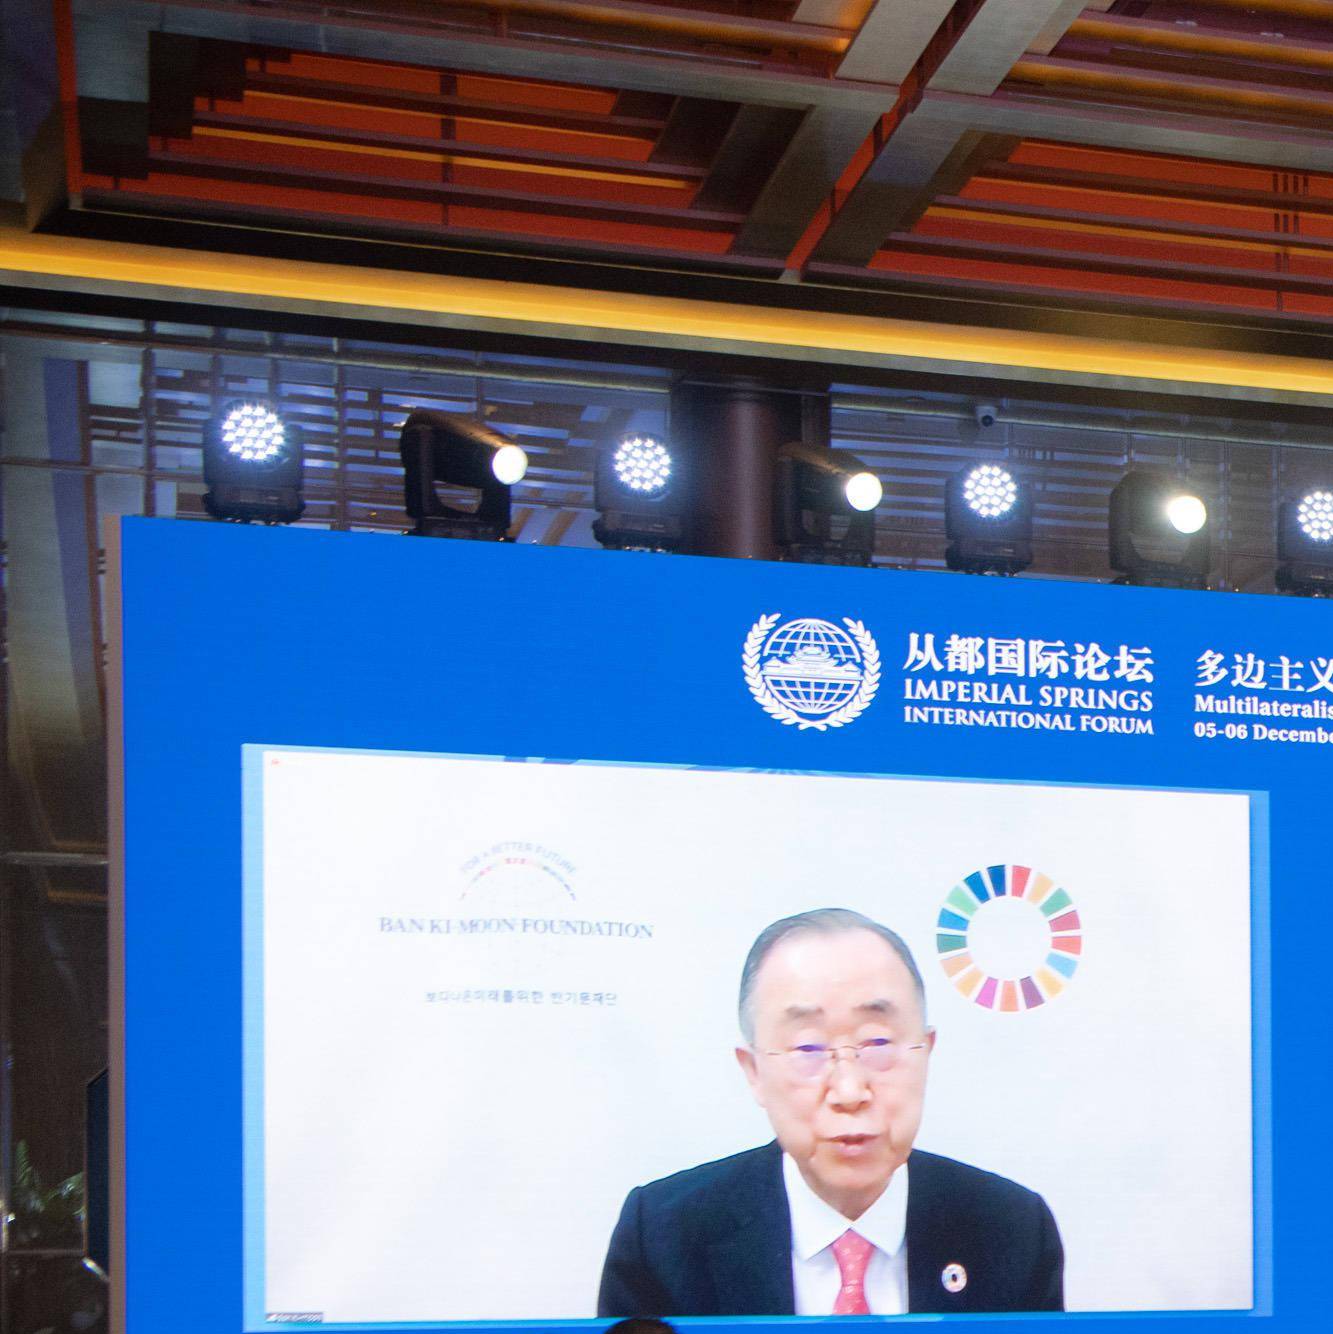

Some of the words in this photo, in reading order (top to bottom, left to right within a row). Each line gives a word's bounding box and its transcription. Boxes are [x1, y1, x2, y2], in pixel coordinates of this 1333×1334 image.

[902, 632, 1154, 684] 从都国际论坛
[904, 678, 1033, 706] IMPERIAL
[1040, 685, 1153, 712] SPRINGS
[904, 705, 1076, 731] INTERNATIONAL
[1080, 715, 1155, 736] FORUM
[1194, 722, 1248, 740] 05-06
[379, 917, 423, 933] BAN
[522, 918, 654, 938] FOUNDATION
